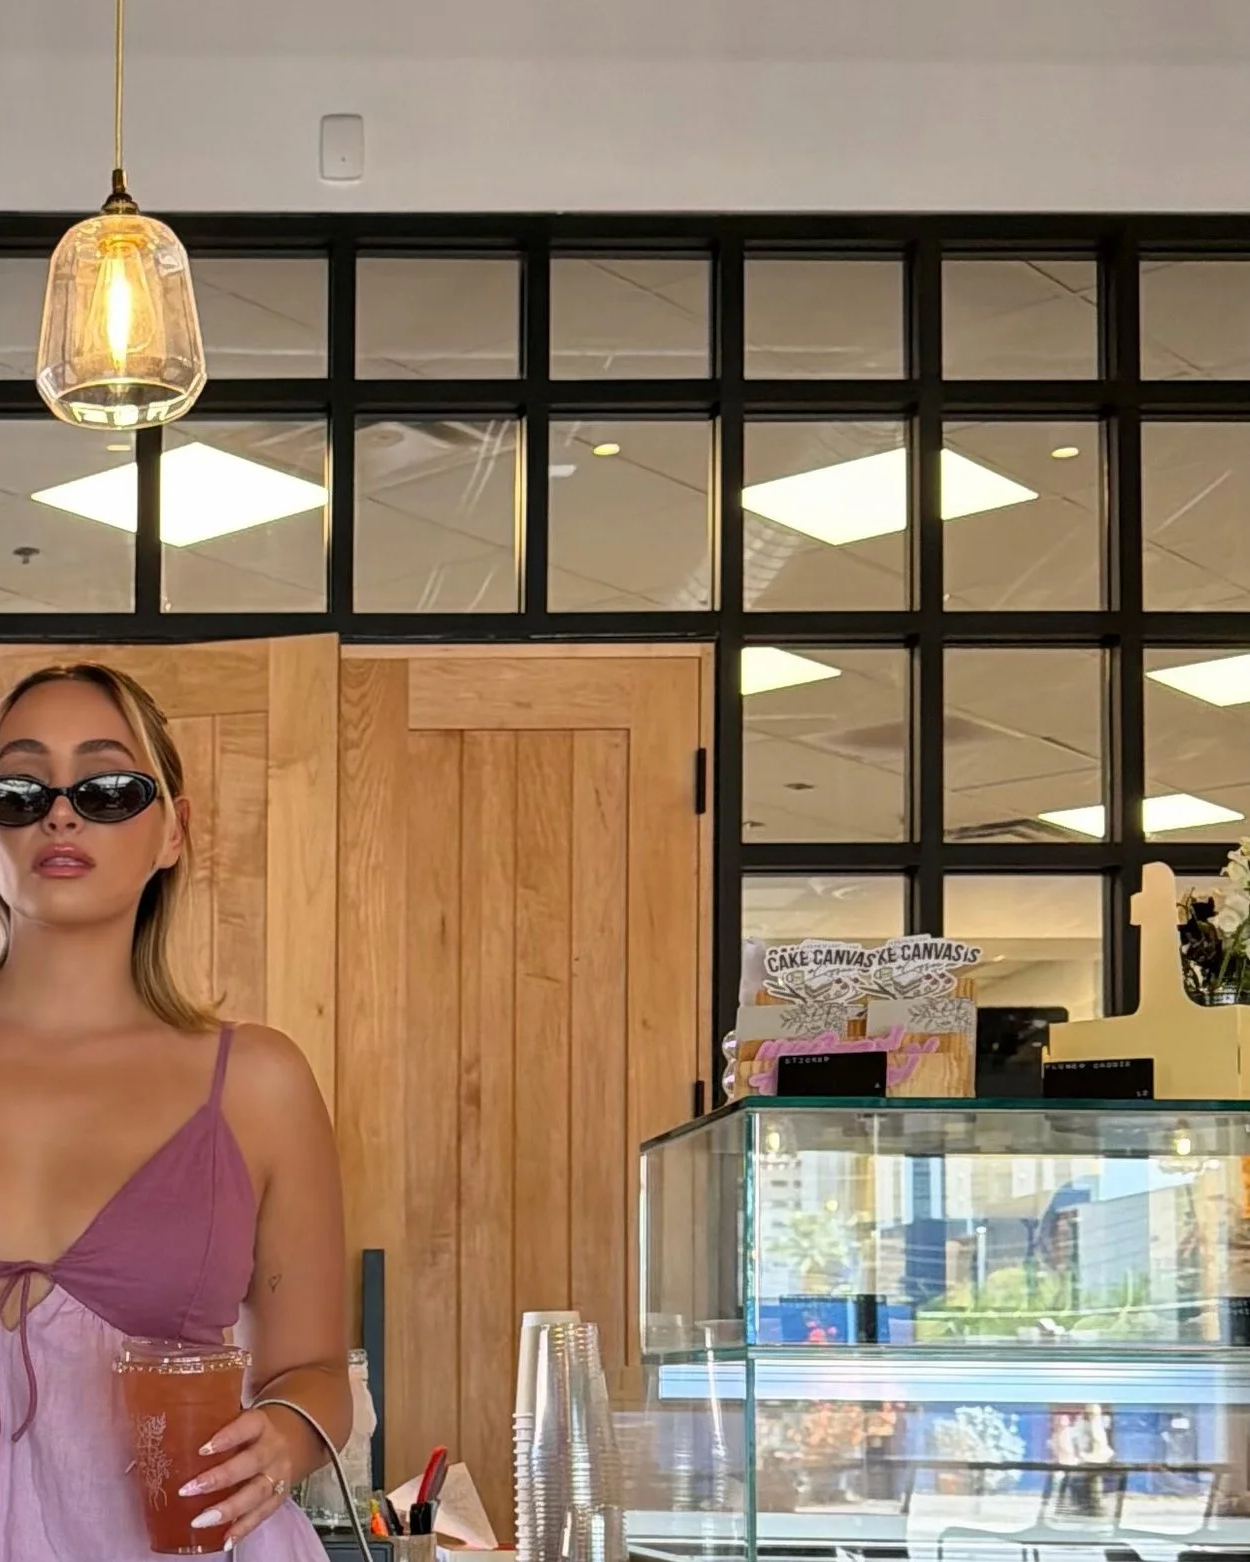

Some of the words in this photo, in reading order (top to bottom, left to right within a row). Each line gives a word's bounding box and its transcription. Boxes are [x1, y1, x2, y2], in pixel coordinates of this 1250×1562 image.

[767, 950, 809, 973] CAKE
[813, 949, 877, 968] CANVAS
[901, 942, 964, 962] CANVAS
